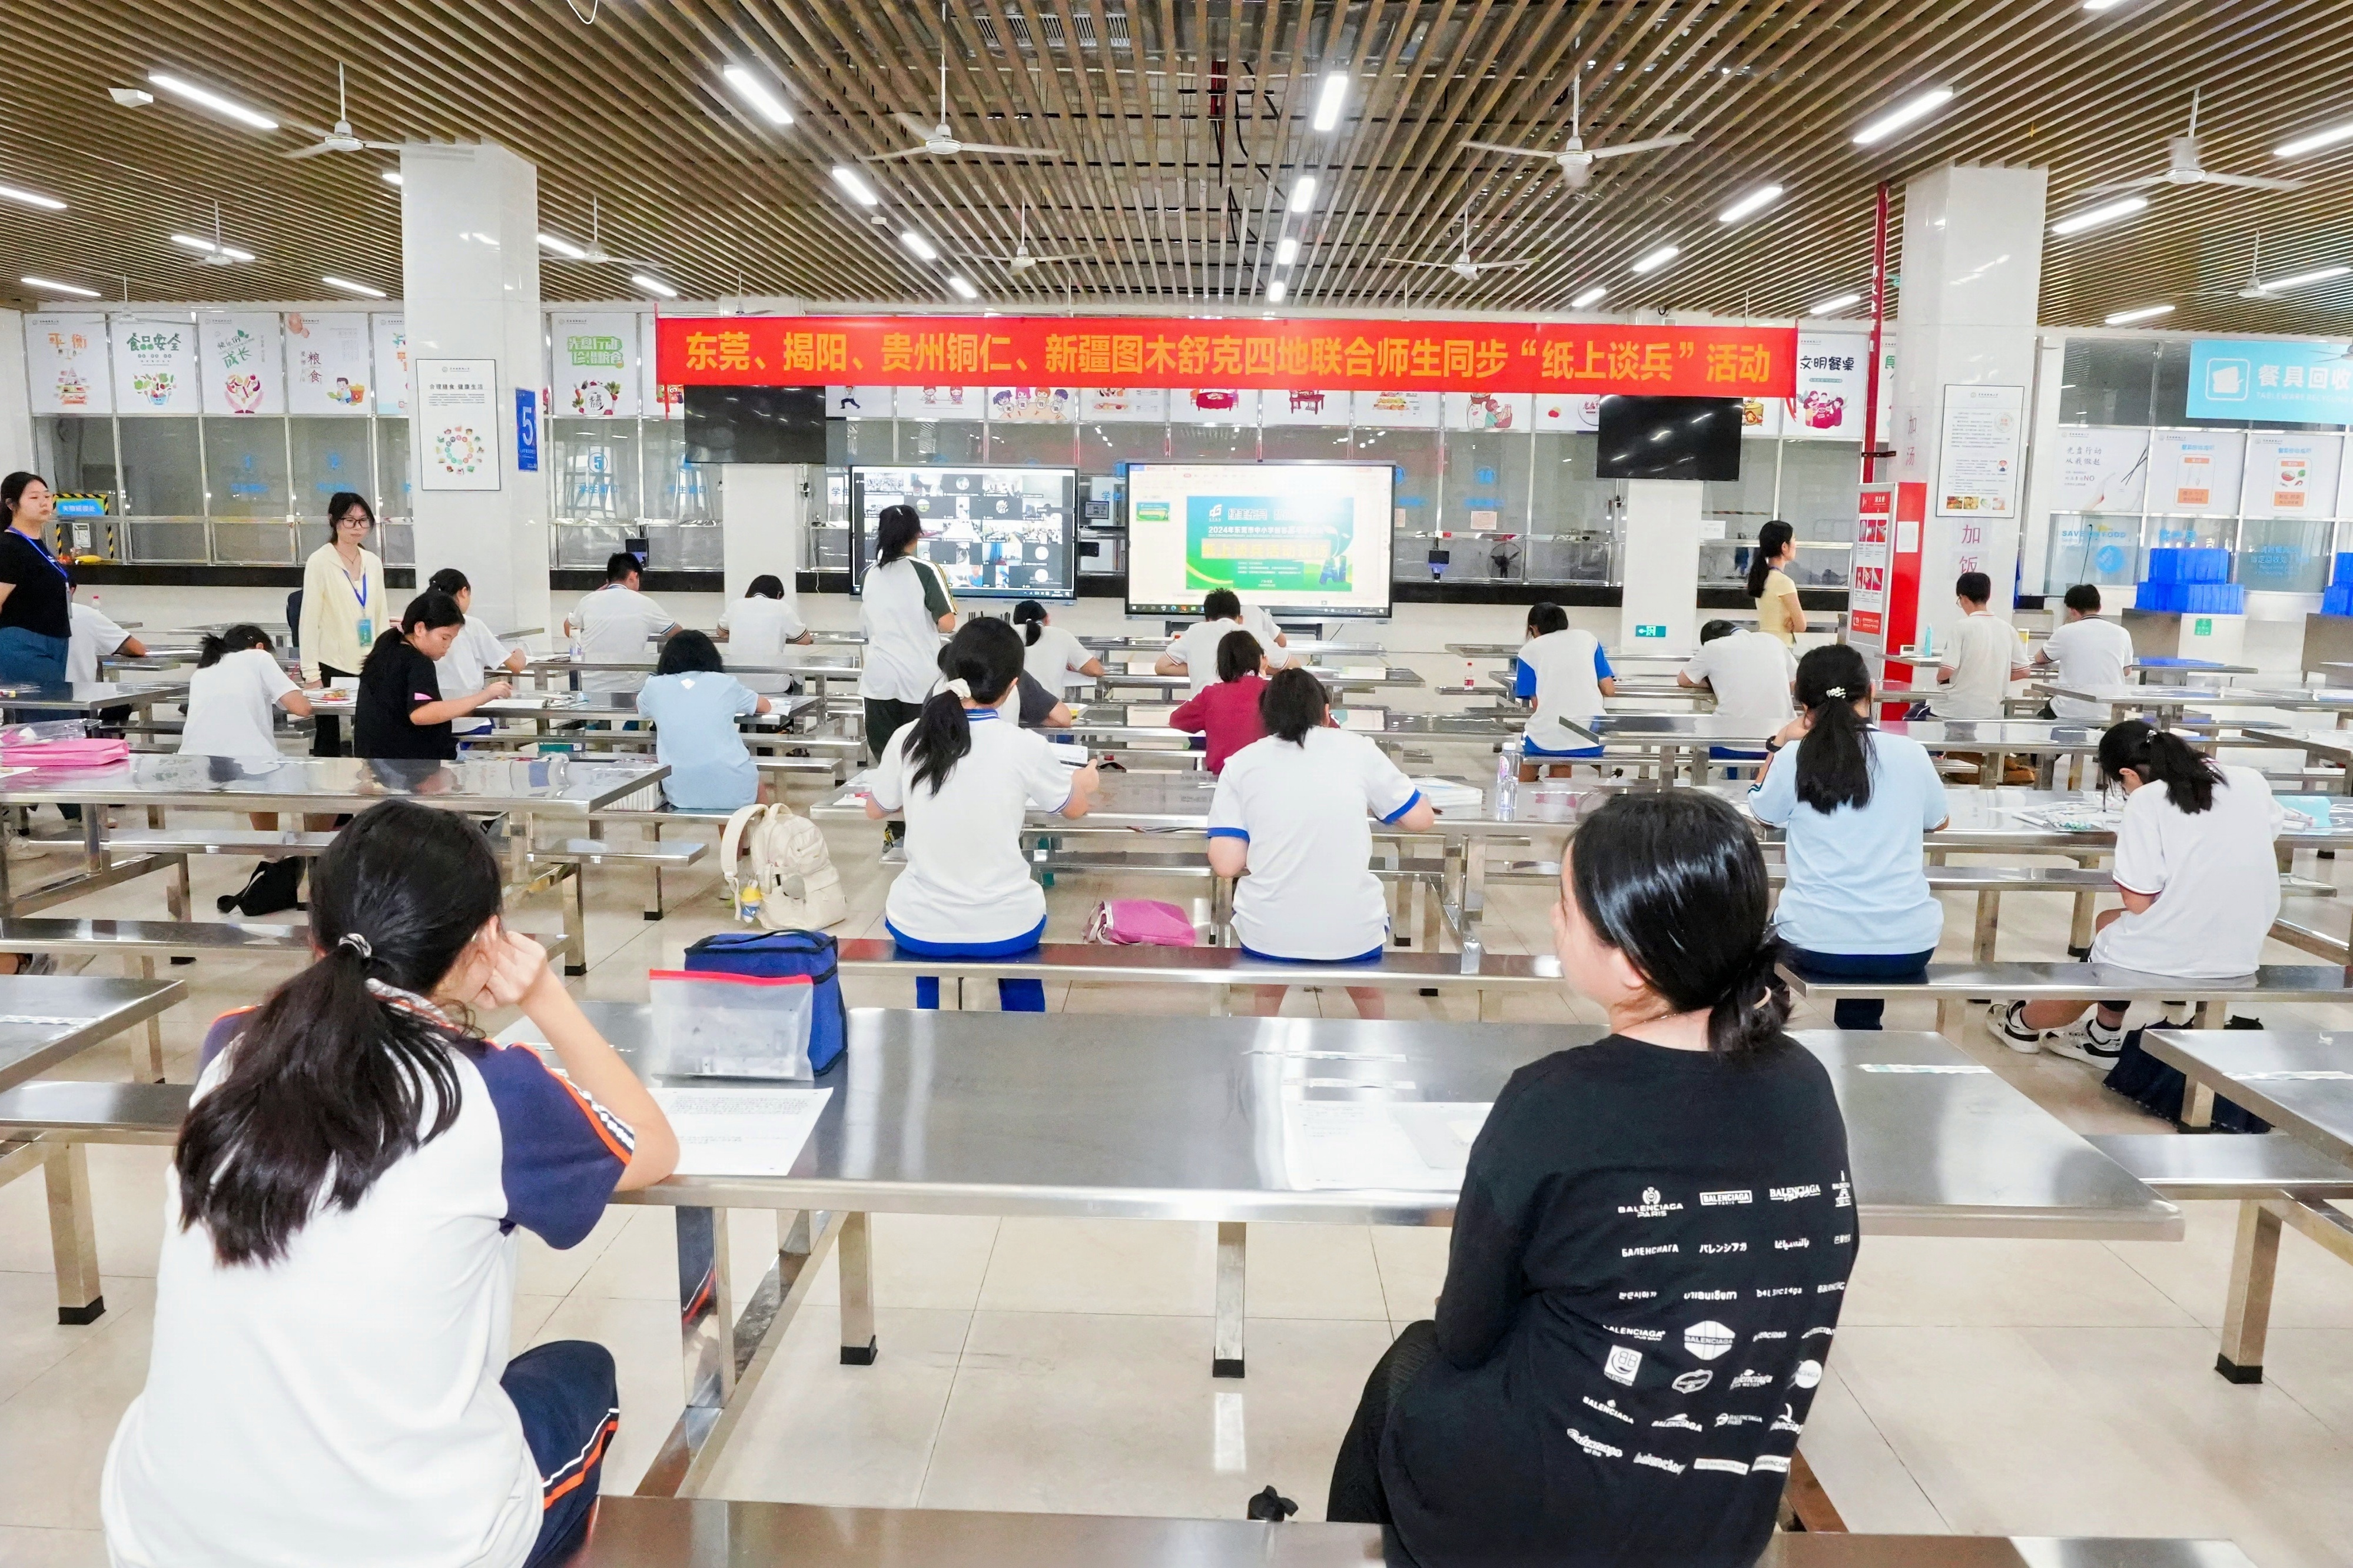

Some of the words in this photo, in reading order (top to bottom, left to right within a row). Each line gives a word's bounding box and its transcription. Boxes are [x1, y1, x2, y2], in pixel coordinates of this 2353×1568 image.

[127, 332, 181, 351] 食品安全
[222, 346, 253, 368] 成长
[1800, 355, 1854, 371] 文明餐桌
[307, 351, 322, 383] 粮食
[2258, 364, 2352, 391] 餐具回收
[522, 406, 533, 446] 5
[1906, 415, 1917, 466] 加汤
[594, 456, 603, 470] 5
[1703, 1192, 1750, 1203] BALENCIAGA
[1618, 1202, 1684, 1214] BALENCIAGA
[1637, 1210, 1667, 1218] PARIS
[1684, 1336, 1733, 1345] BALENCIAGA
[1582, 1396, 1634, 1424] BALENCIAGA
[1651, 1420, 1703, 1433] BALENCIAGA
